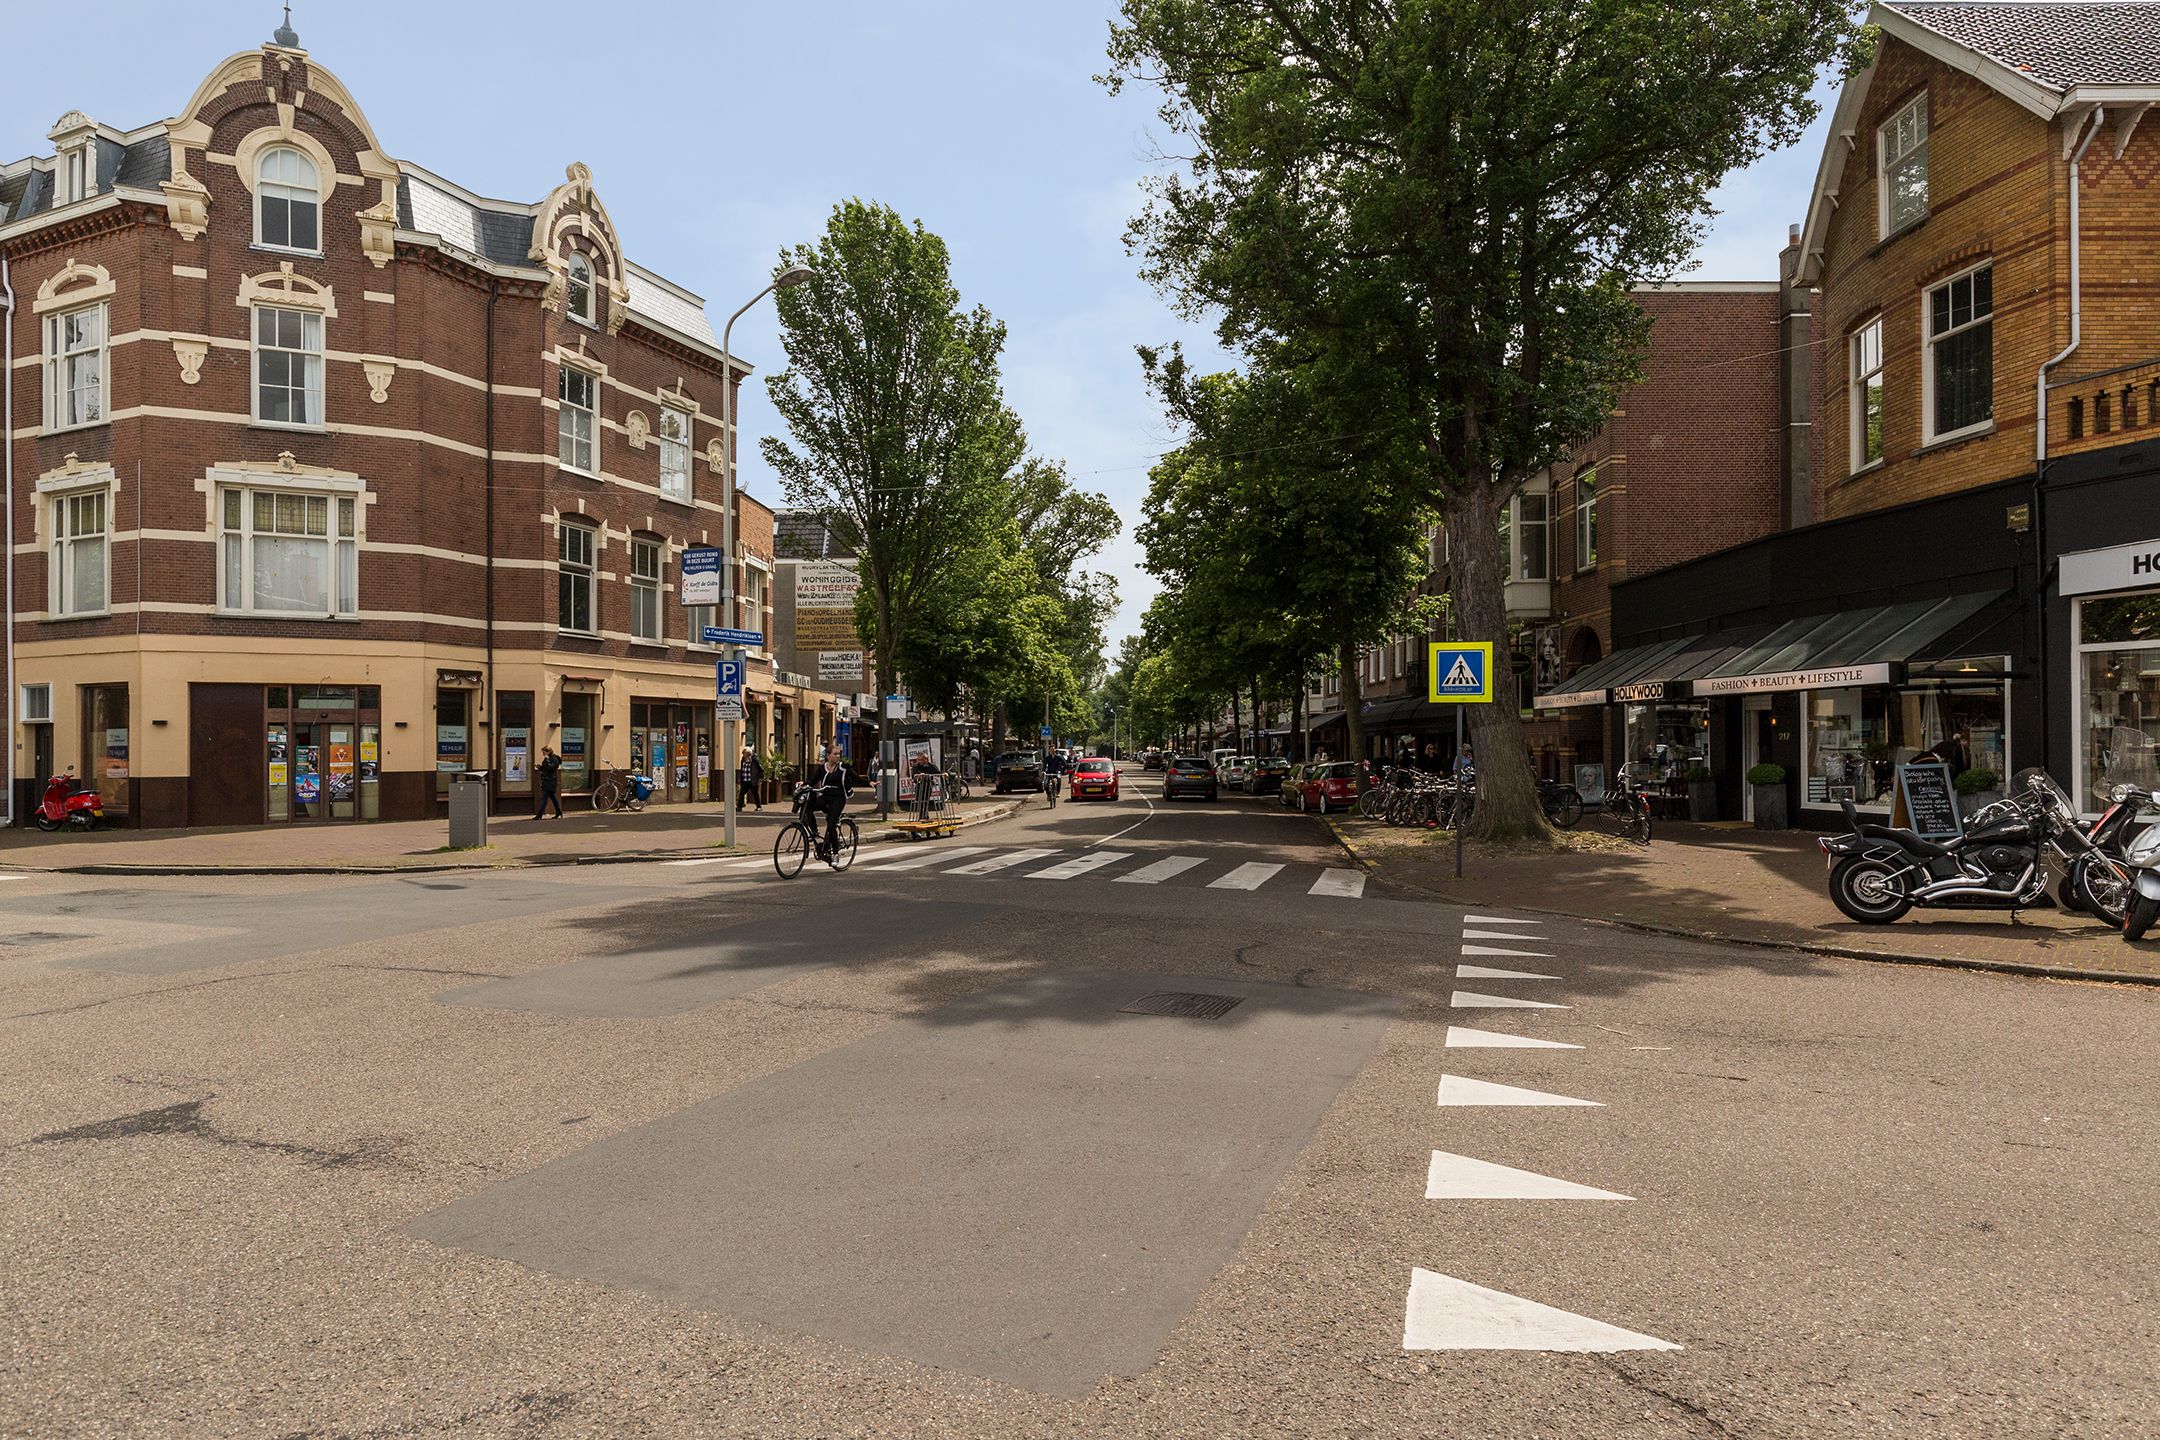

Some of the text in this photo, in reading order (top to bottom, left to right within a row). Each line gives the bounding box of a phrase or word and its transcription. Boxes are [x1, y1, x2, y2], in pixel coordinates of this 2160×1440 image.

[730, 631, 758, 639] Hendriklaan
[722, 664, 736, 681] P
[1711, 670, 1862, 691] FASHION BEAUTY LIFESTYLE
[1615, 683, 1663, 700] HOLLYWOOD
[1778, 733, 1790, 741] 217
